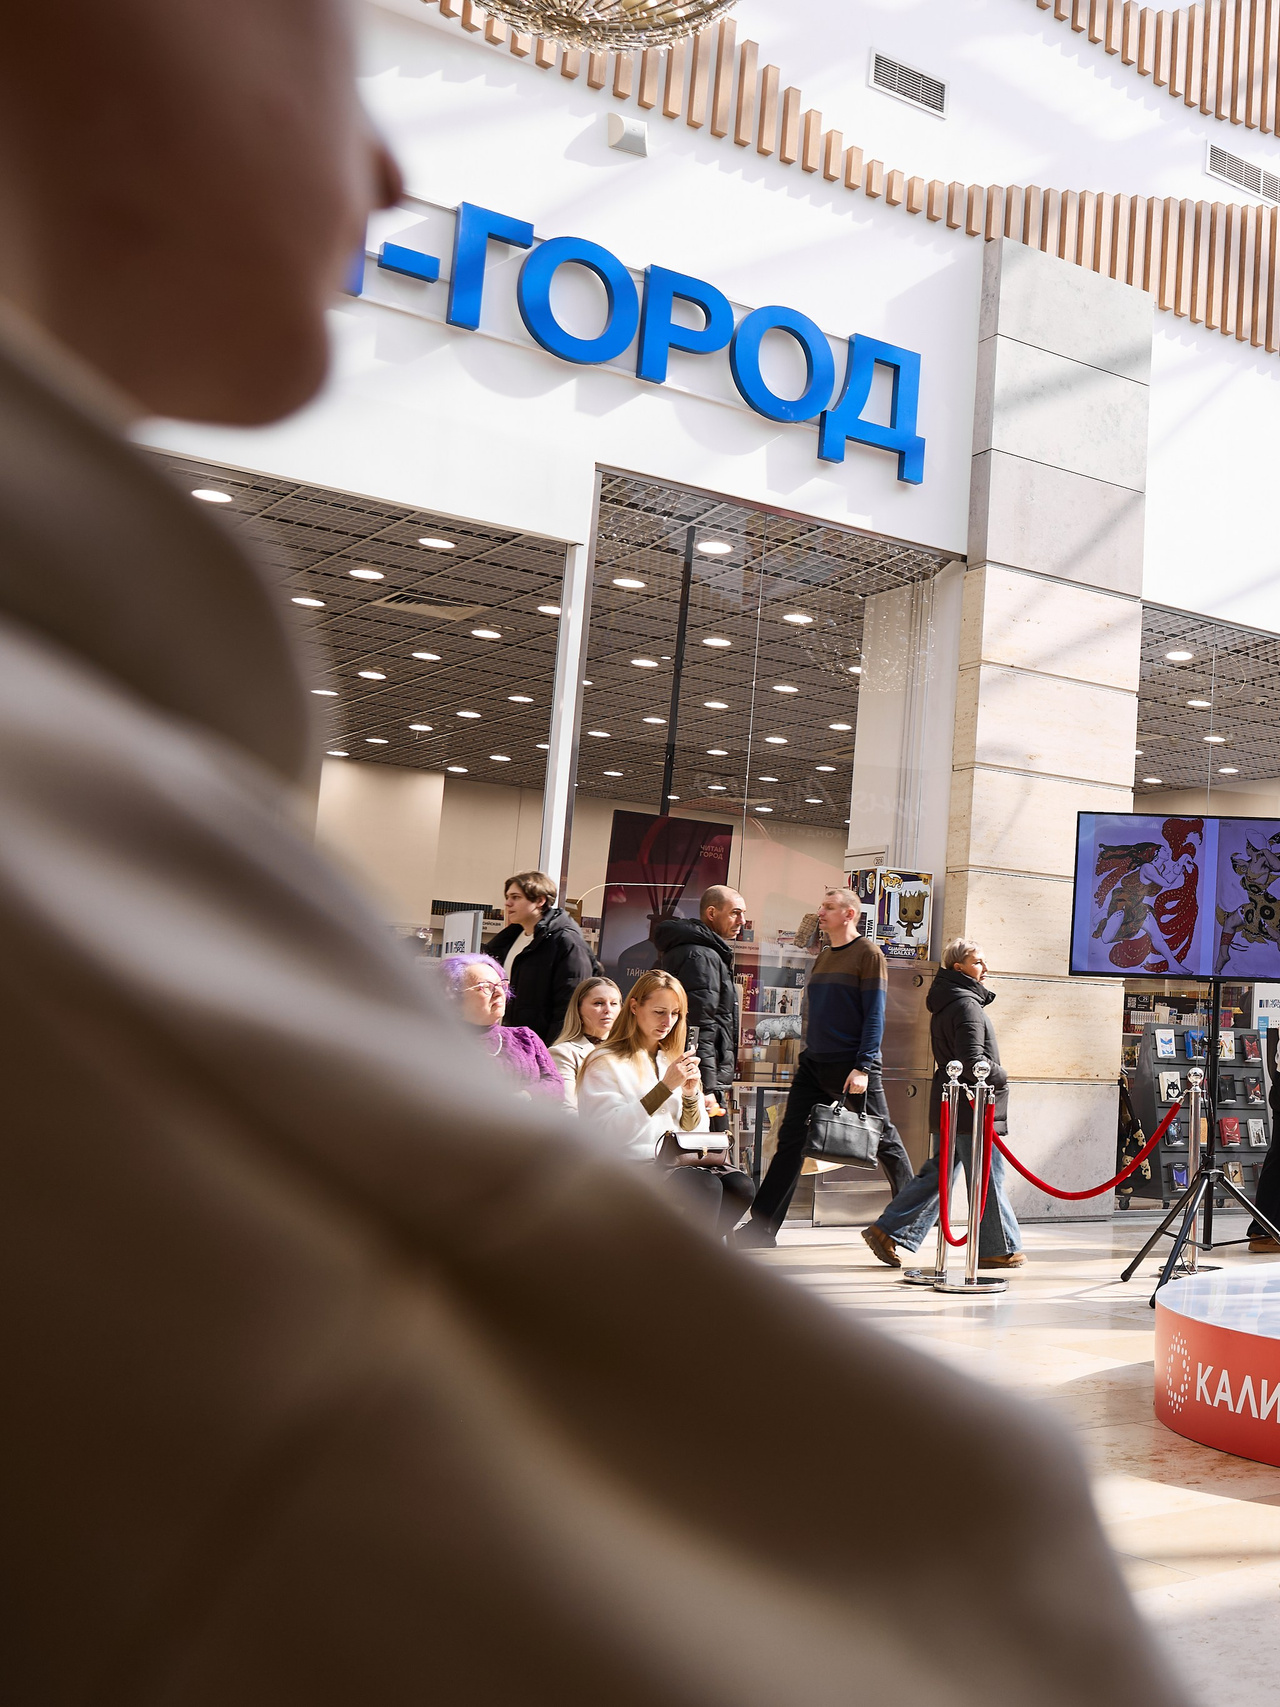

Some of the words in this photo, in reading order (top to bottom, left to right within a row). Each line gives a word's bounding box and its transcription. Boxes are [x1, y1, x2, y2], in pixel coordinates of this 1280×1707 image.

[343, 201, 926, 486] -ГОРОД
[700, 844, 725, 853] ЧИТАЙ
[699, 851, 724, 860] ГОРОД
[882, 874, 903, 889] POP!
